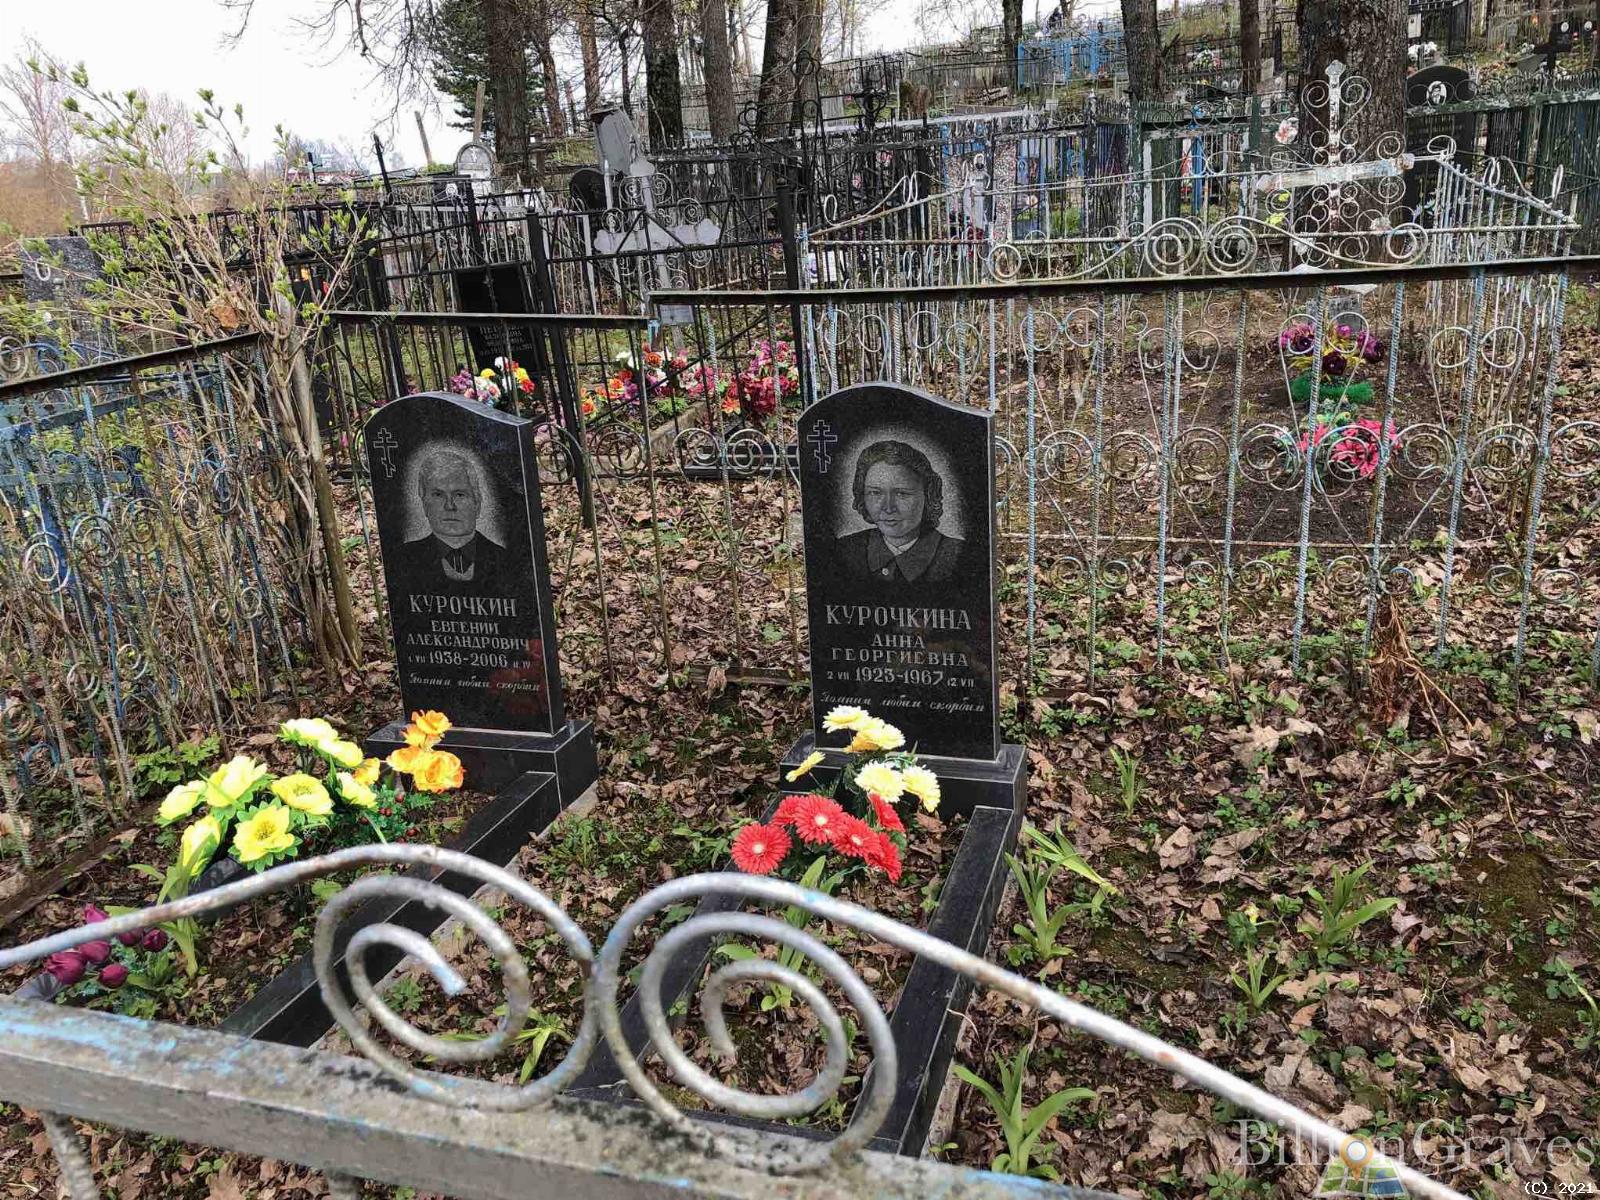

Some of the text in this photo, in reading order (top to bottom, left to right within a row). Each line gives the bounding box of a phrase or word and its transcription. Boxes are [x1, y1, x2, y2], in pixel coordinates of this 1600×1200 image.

[408, 594, 518, 617] КУРОЧКИН
[825, 603, 972, 631] КУРОЧКИНА
[406, 633, 530, 651] АЛЕКСАНДРОВИЧ
[871, 634, 926, 649] АННА
[429, 650, 508, 668] 1938-2006
[832, 648, 969, 667] ГЕОРГИЕВНА
[855, 666, 944, 686] 1923-1967
